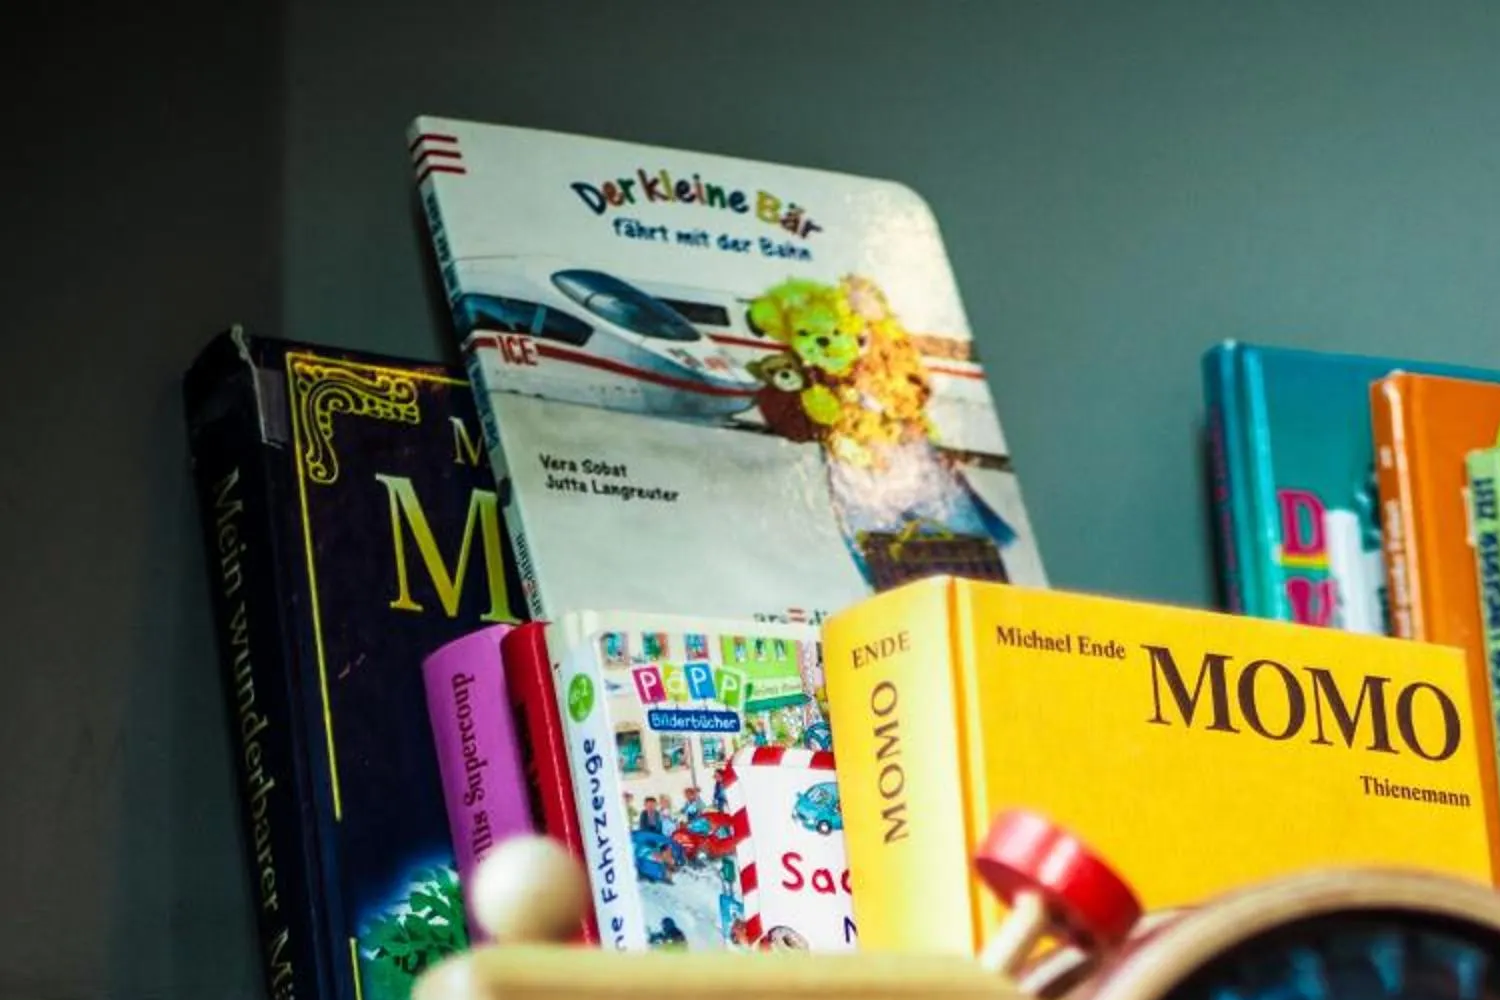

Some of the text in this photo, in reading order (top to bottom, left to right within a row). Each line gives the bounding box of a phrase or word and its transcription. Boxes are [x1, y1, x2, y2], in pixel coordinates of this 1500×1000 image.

[570, 168, 822, 239] Der kleine Bär
[613, 217, 812, 260] fährt mit der Bahn
[495, 334, 538, 366] ICE
[538, 453, 627, 478] Vera Sobat
[545, 474, 680, 502] Jutta Langreuter
[851, 630, 911, 669] ENDE
[996, 624, 1127, 661] Michael Ende
[211, 467, 245, 597] Mein
[228, 600, 280, 912] wunderbarer
[1140, 642, 1462, 763] MOMO
[451, 672, 489, 805] Supercoup
[651, 713, 738, 730] Bilderbücher
[870, 679, 909, 845] MOMO
[1359, 774, 1472, 808] Thienemann
[582, 737, 618, 903] Fahrzeuge
